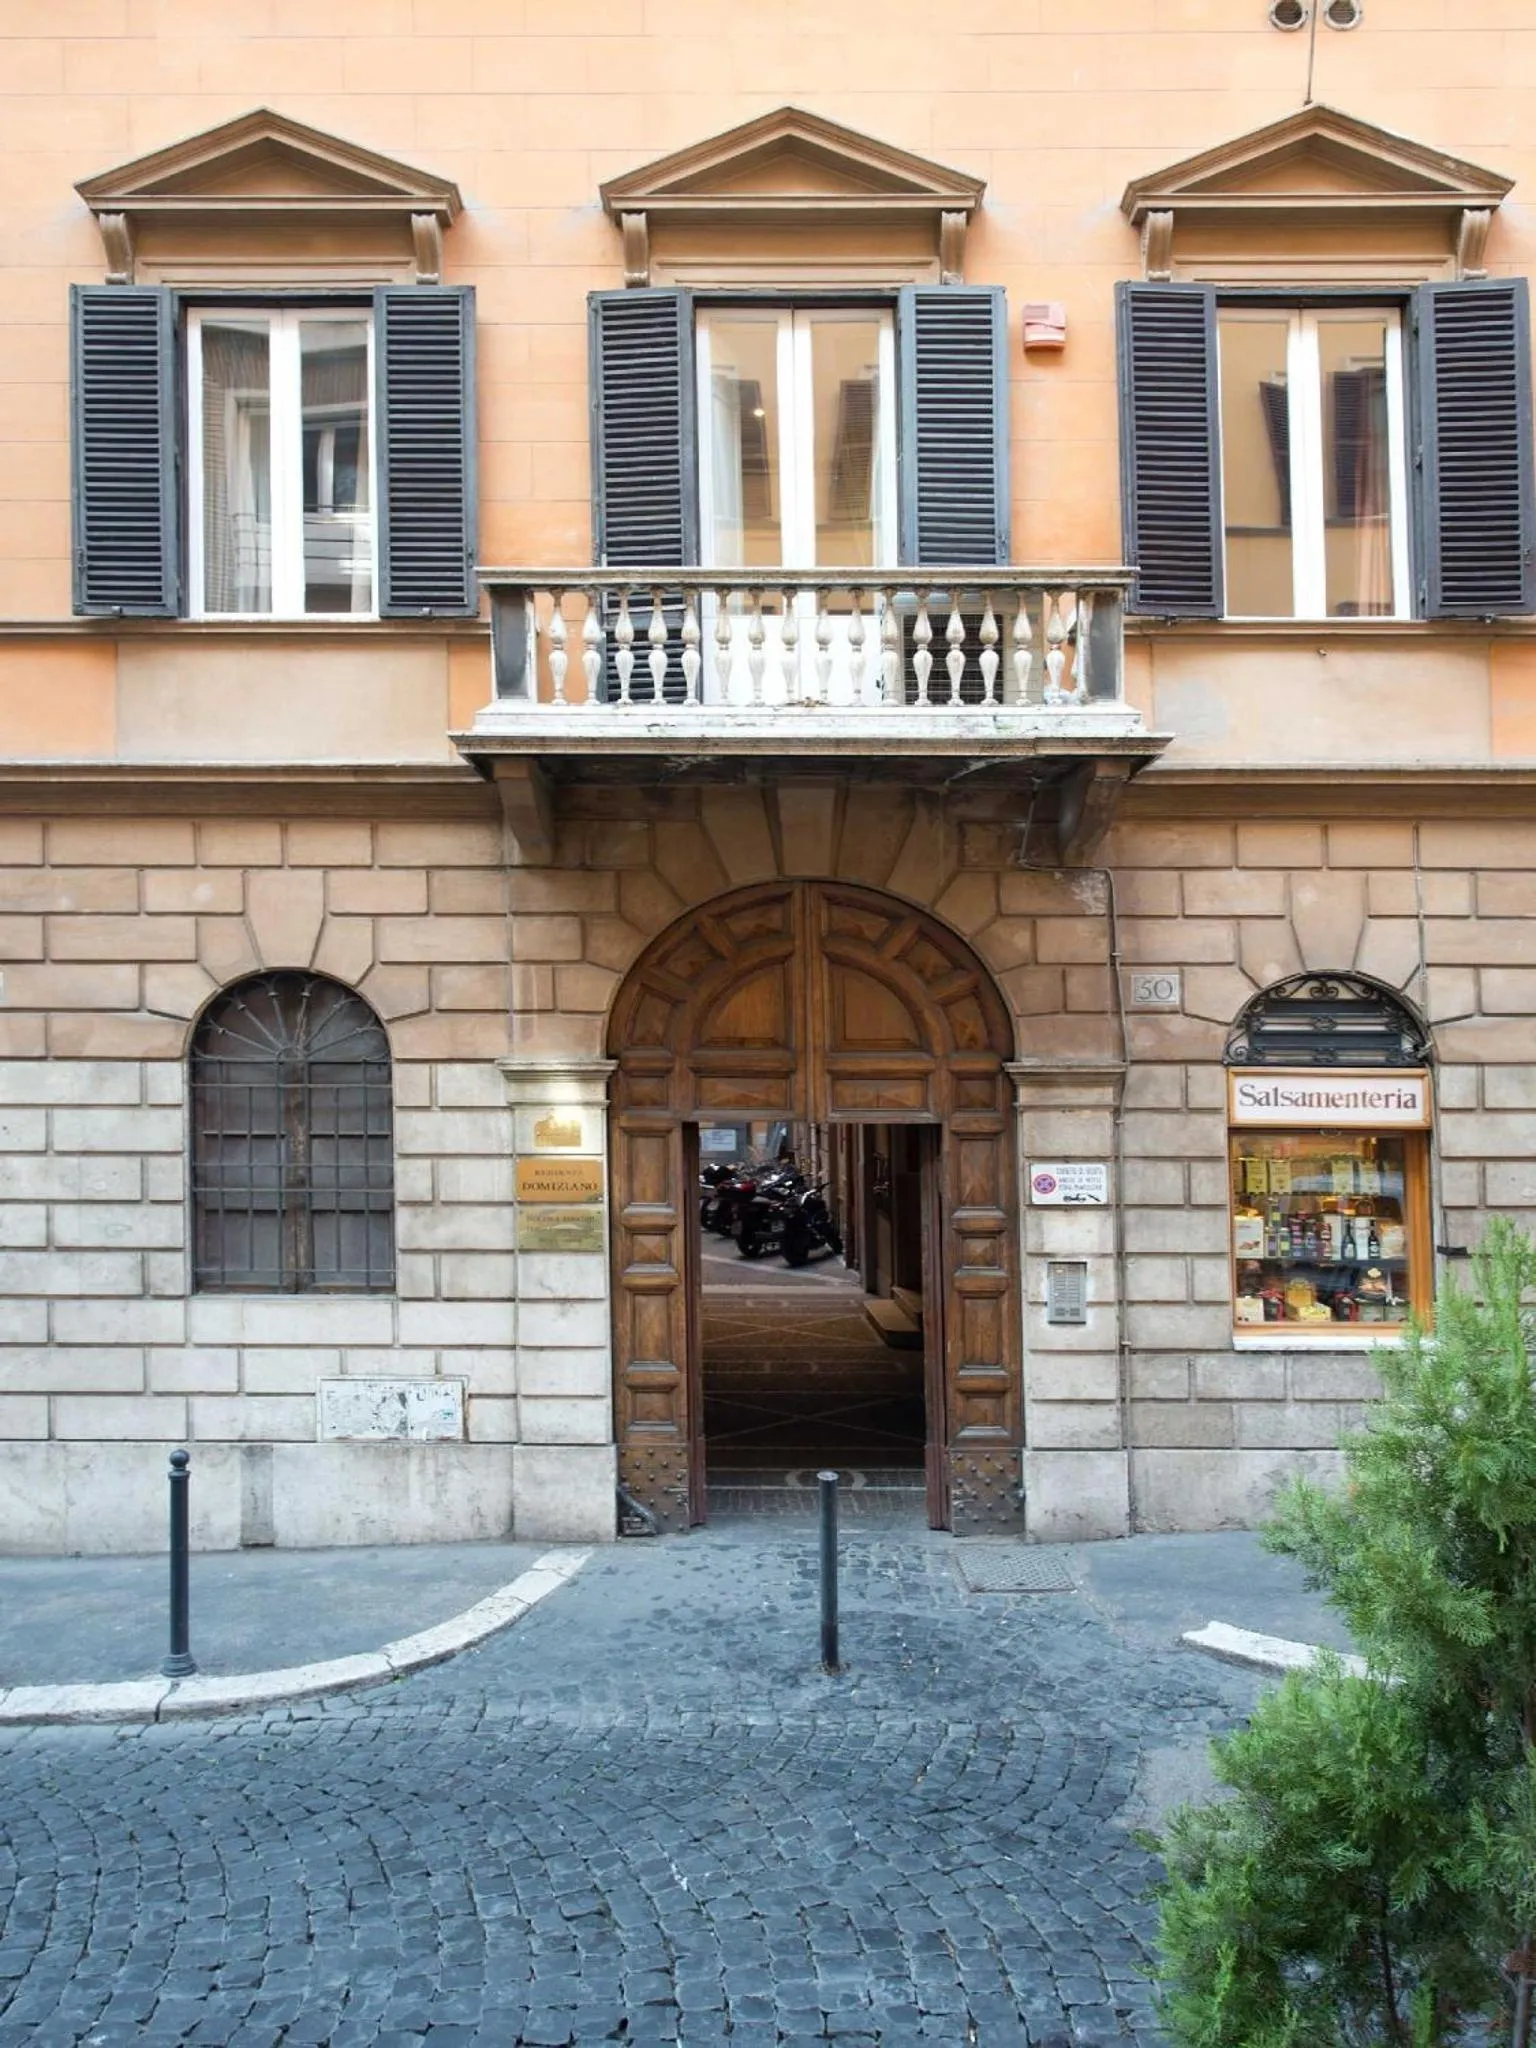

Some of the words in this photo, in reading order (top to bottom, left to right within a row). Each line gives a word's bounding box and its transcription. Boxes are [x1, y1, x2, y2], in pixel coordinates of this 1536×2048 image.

[1139, 978, 1173, 1000] 50
[1239, 1083, 1417, 1110] Salsamenteria
[522, 1181, 598, 1192] DOMIZIANO
